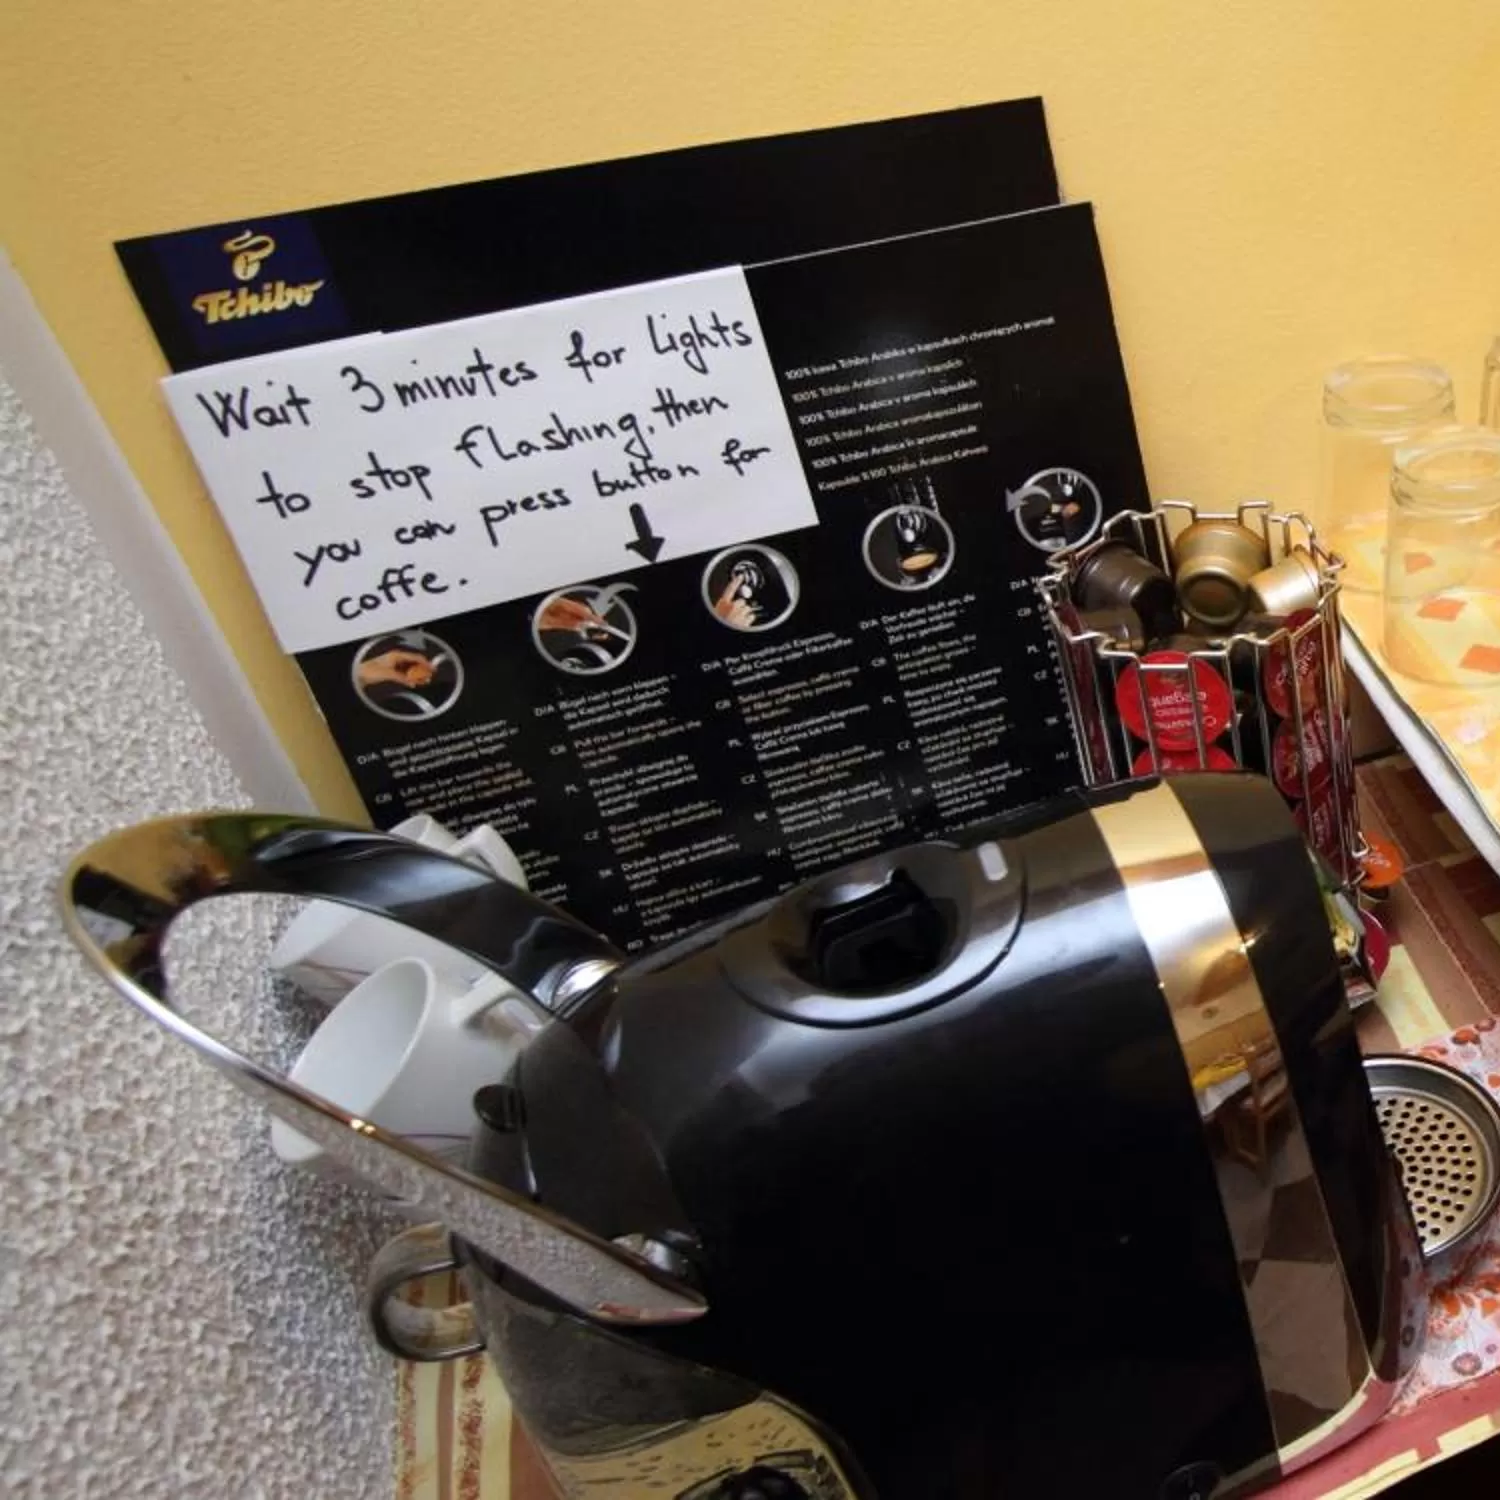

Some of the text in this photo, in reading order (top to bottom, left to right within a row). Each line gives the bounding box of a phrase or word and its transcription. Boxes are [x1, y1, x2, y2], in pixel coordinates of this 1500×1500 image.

[192, 278, 325, 324] Tchibo
[784, 365, 811, 381] 100%
[838, 353, 869, 370] Tchibo
[197, 378, 310, 440] Wait
[340, 365, 386, 414] 3
[394, 347, 538, 408] minutes
[571, 330, 627, 387] for
[791, 389, 818, 405] 100%
[819, 382, 850, 398] Tchibo
[797, 410, 825, 426] 100%
[825, 403, 857, 420] Tchibo
[805, 433, 831, 448] 100%
[832, 426, 863, 442] Tchibo
[256, 472, 310, 520] to
[351, 452, 432, 500] stop
[655, 388, 729, 434] then
[811, 455, 837, 470] 100%
[838, 448, 869, 464] Tchibo
[888, 460, 917, 475] Tchibo
[294, 438, 772, 587] you can press button for
[335, 565, 470, 622] coffe.
